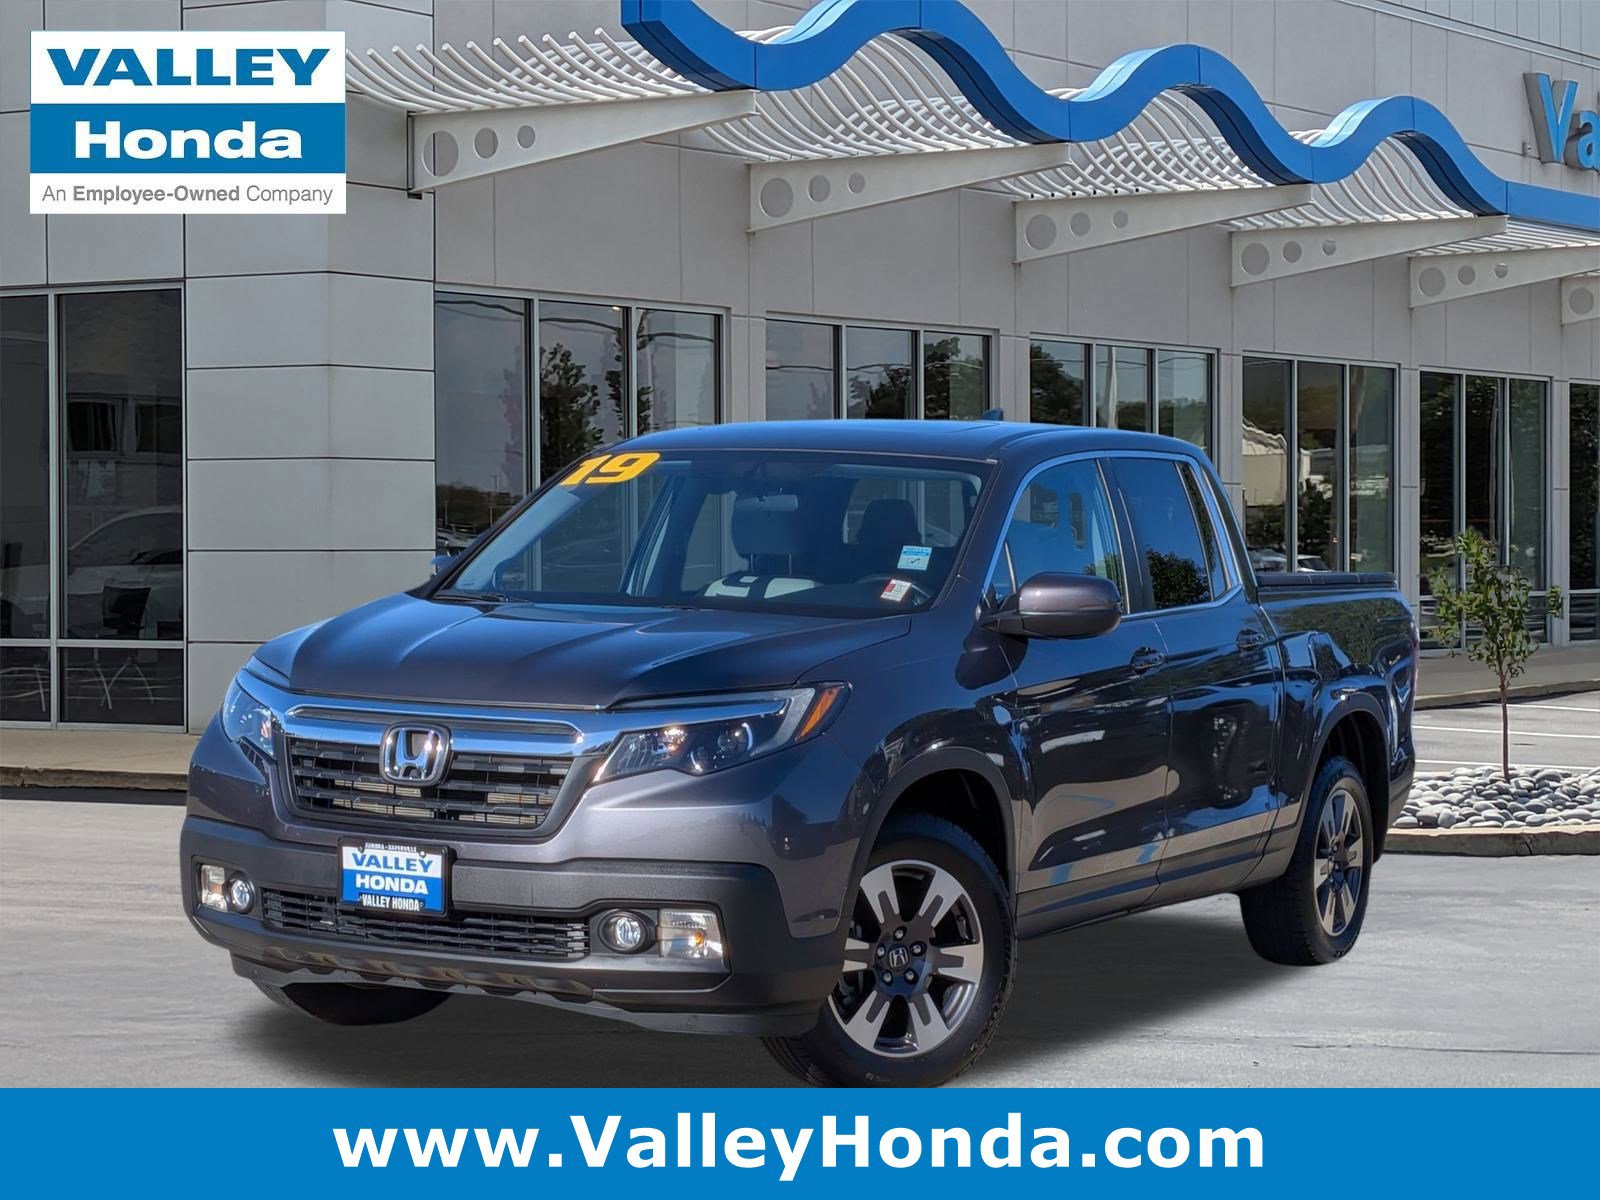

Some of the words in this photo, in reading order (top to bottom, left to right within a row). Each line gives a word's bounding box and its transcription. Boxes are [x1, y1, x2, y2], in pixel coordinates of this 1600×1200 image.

[560, 452, 661, 485] 19
[352, 853, 433, 873] VALLEY
[355, 873, 429, 895] HONDA
[361, 893, 391, 909] VALLEY
[391, 896, 420, 912] HONDA
